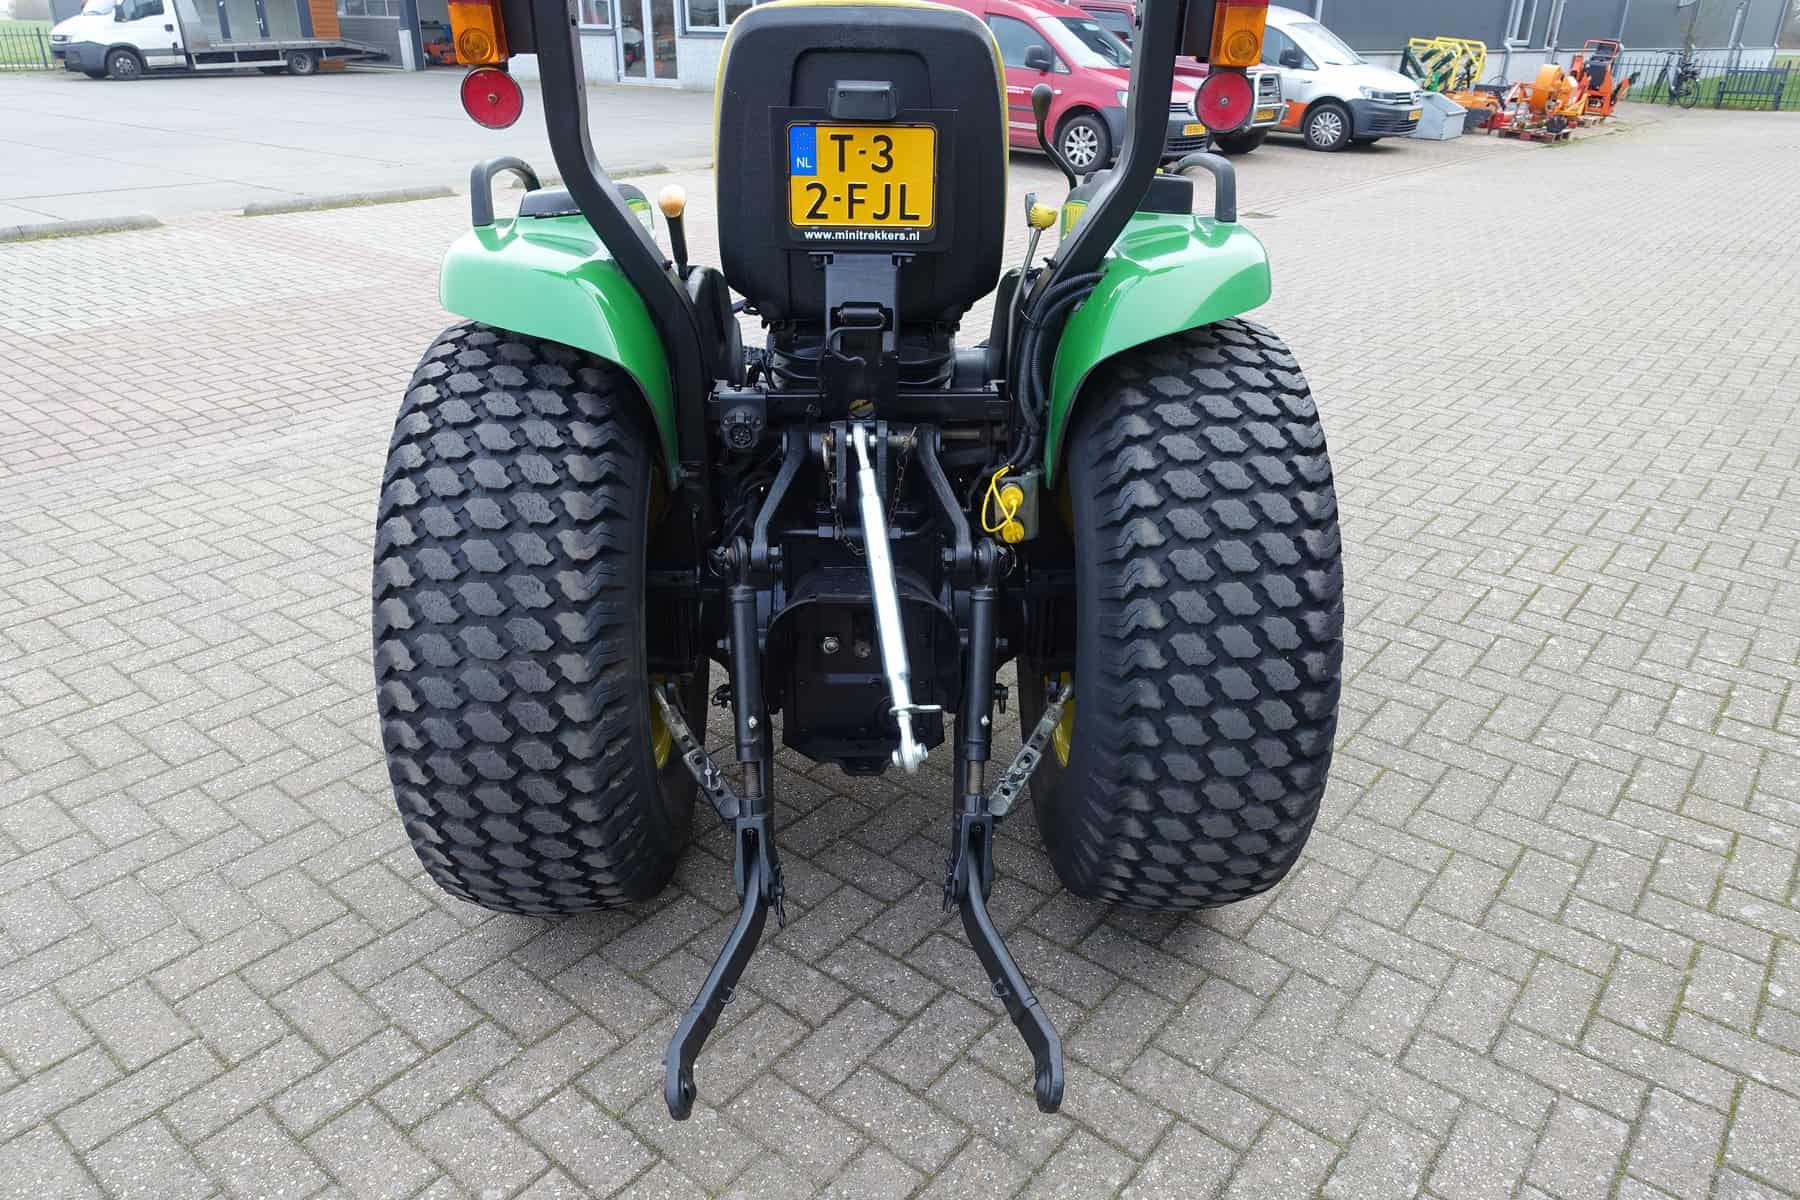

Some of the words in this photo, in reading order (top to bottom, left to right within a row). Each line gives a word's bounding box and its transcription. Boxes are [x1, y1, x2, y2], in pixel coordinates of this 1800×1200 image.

[796, 157, 812, 169] NL
[829, 134, 894, 173] T-3
[805, 182, 920, 221] 2-FJL
[804, 230, 920, 241] www.minitrekkers.nl
